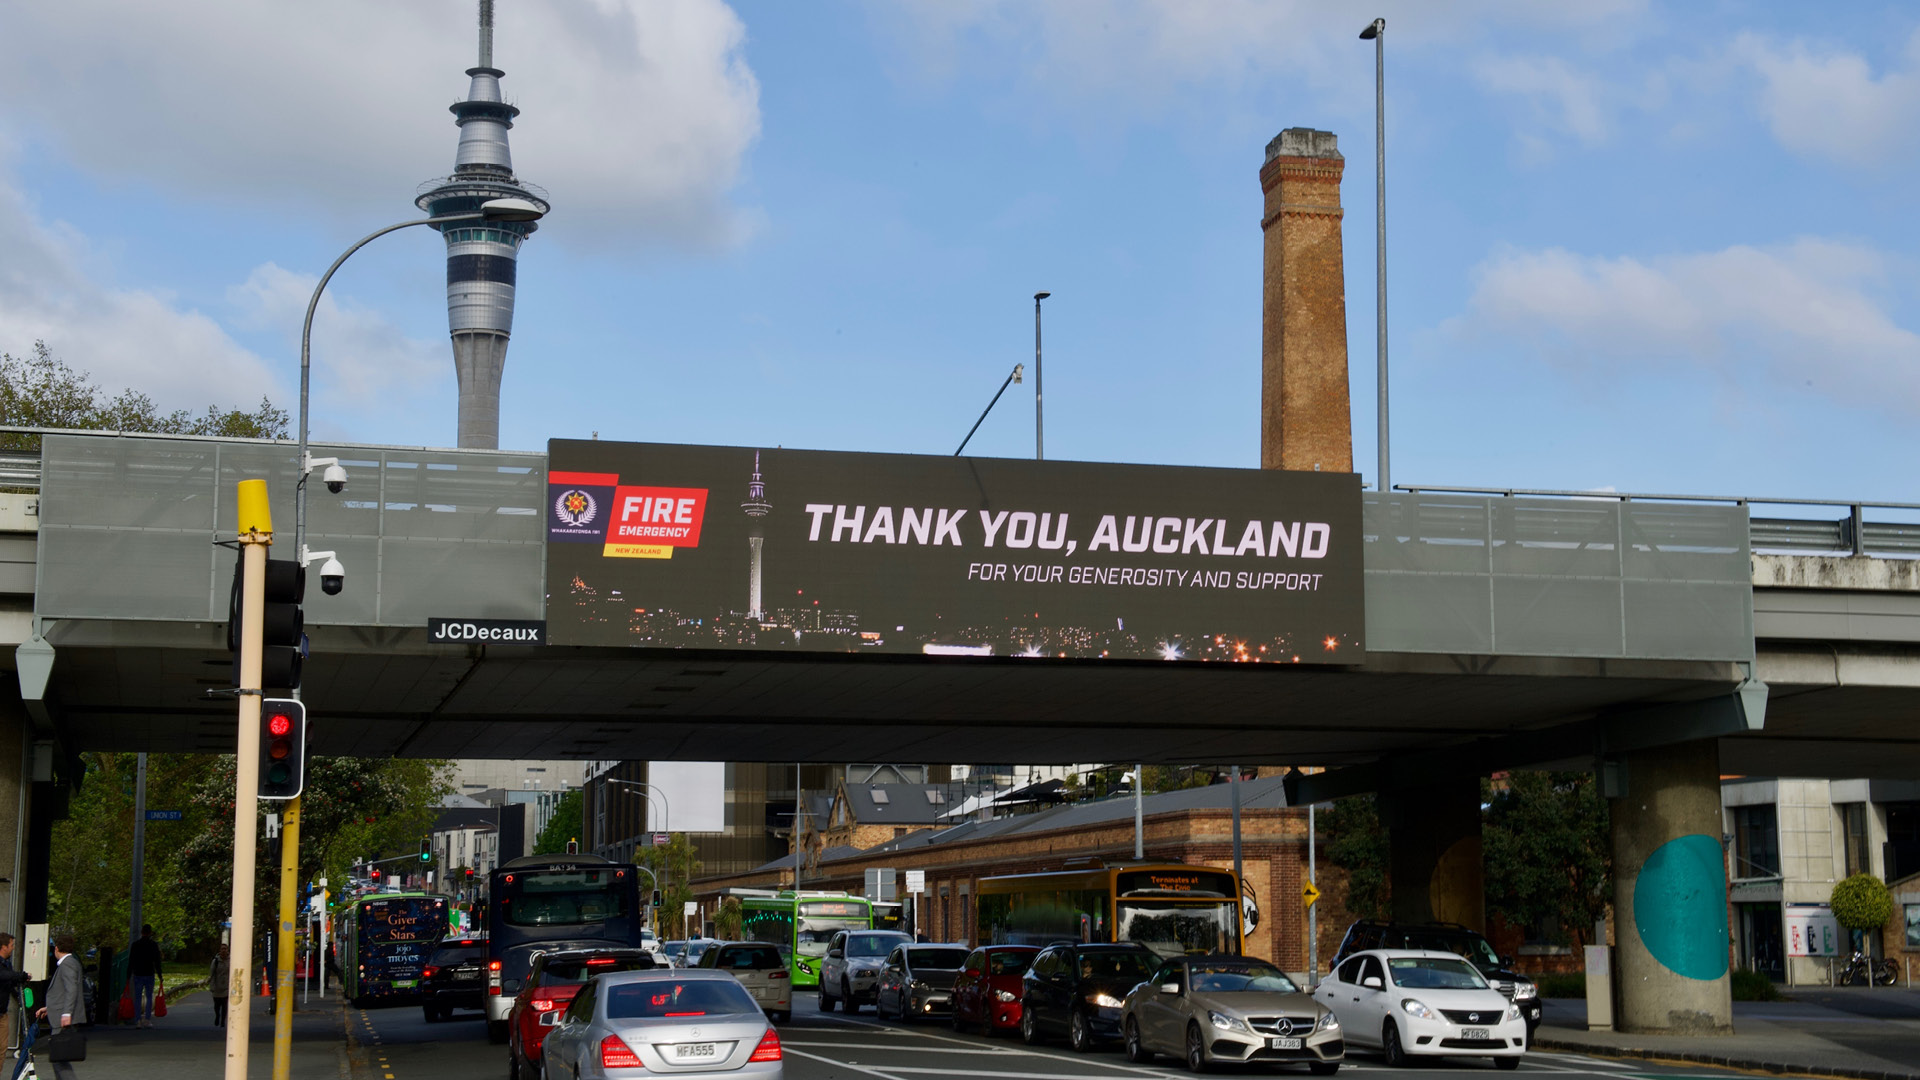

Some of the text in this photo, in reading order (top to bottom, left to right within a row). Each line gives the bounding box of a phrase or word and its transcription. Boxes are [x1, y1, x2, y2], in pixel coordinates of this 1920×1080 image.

[621, 496, 696, 524] FIRE
[618, 525, 690, 538] EMERGENCY
[805, 504, 1331, 559] THANK YOU, AUCKLAND
[632, 547, 662, 555] ZEALAND
[968, 563, 1323, 591] FOR YOUR GENEROSITY AND SUPPORT
[435, 622, 539, 641] JCDecaux
[388, 914, 418, 926] Giver
[389, 929, 416, 941] Stars
[395, 944, 412, 955] jojo
[386, 954, 420, 965] moyes
